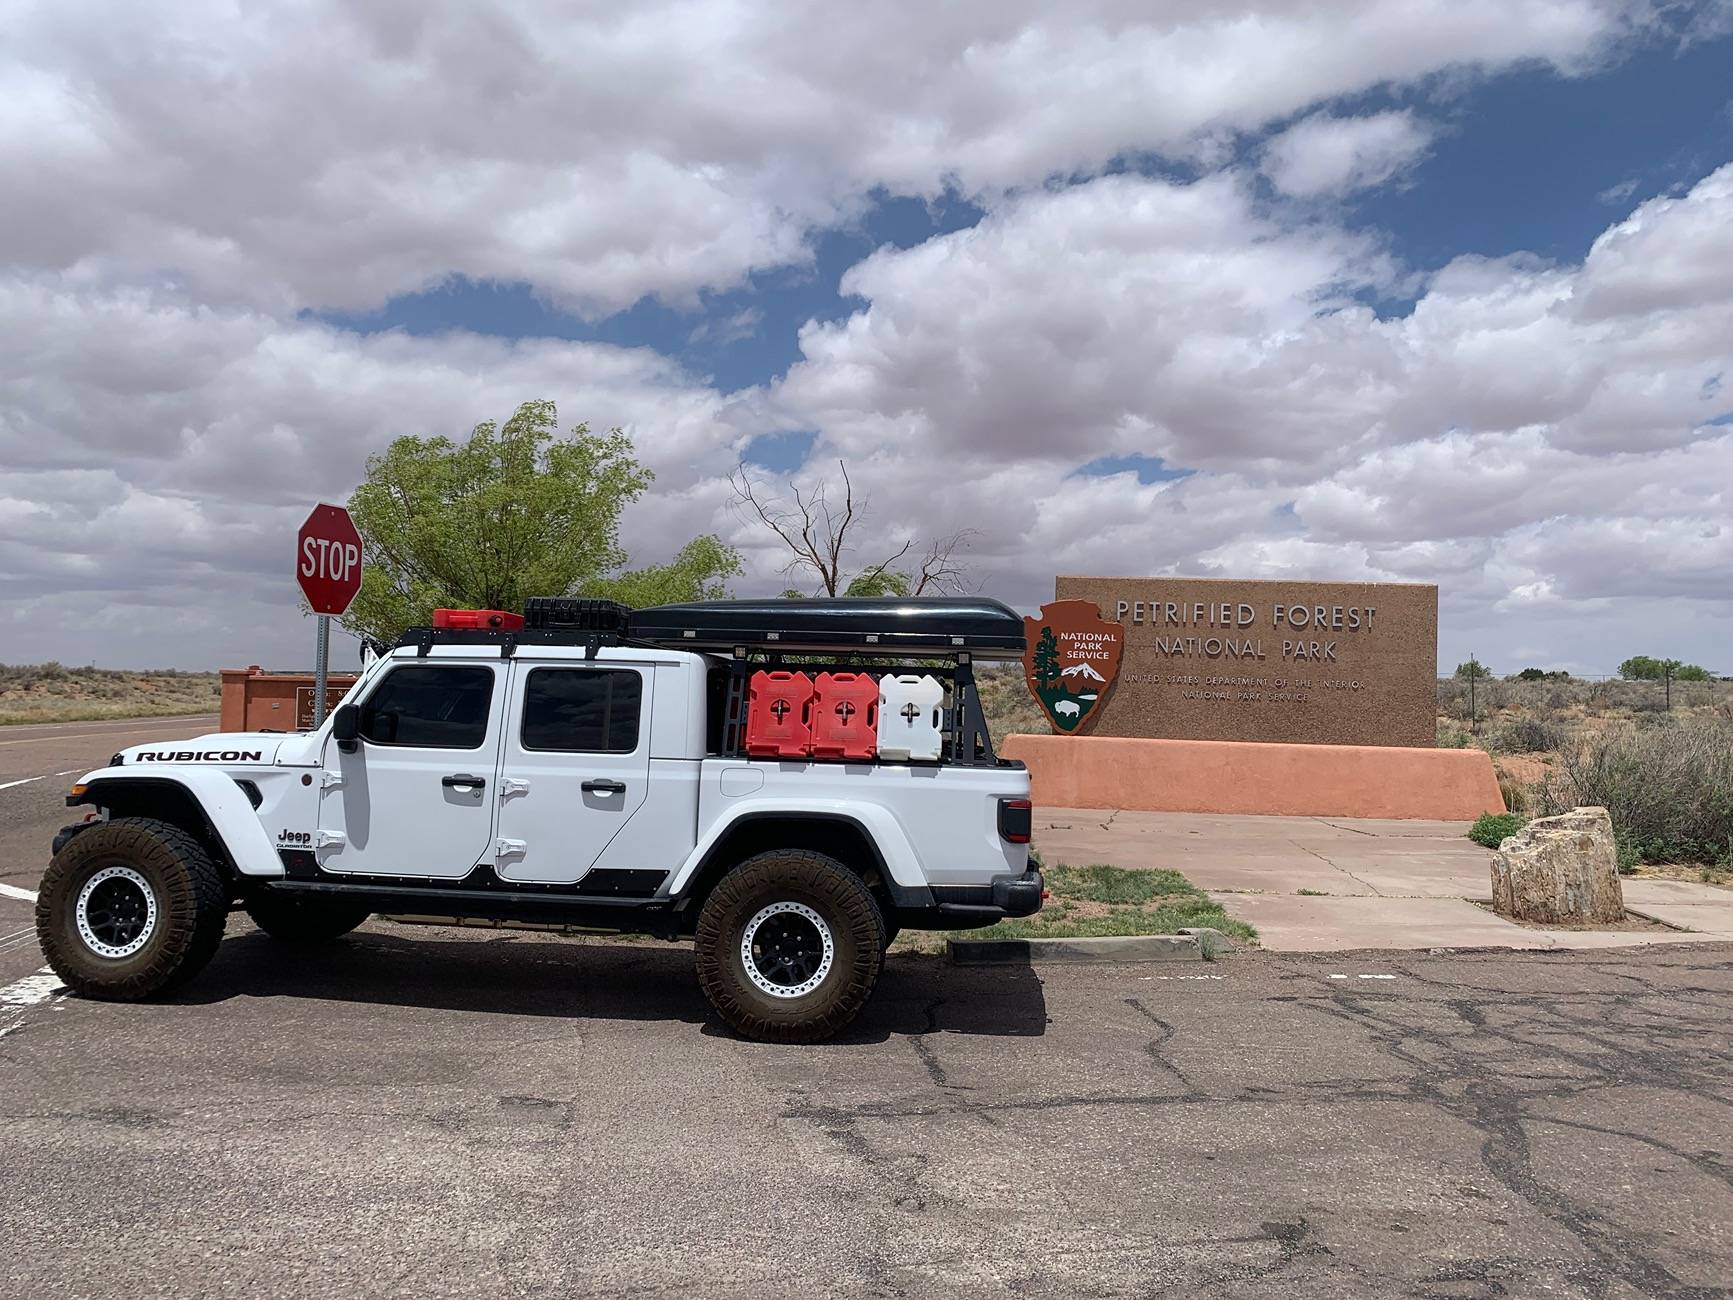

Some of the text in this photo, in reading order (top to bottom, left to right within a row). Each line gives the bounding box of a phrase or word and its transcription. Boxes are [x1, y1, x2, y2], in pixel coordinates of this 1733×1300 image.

[301, 536, 359, 582] STOP
[1116, 600, 1377, 629] PETRIFIED FOREST
[1060, 632, 1117, 642] NATIONAL
[1074, 641, 1103, 651] PARK
[1155, 636, 1336, 659] NATIONAL PARK
[1066, 650, 1110, 660] SERVICE
[1124, 674, 1366, 689] UNITED STATES DEPARTMENT OF THE INTERIOR
[1181, 690, 1309, 701] NATIONAL PARK SERVICE
[135, 751, 262, 762] RUBICON
[278, 829, 311, 844] Jeep
